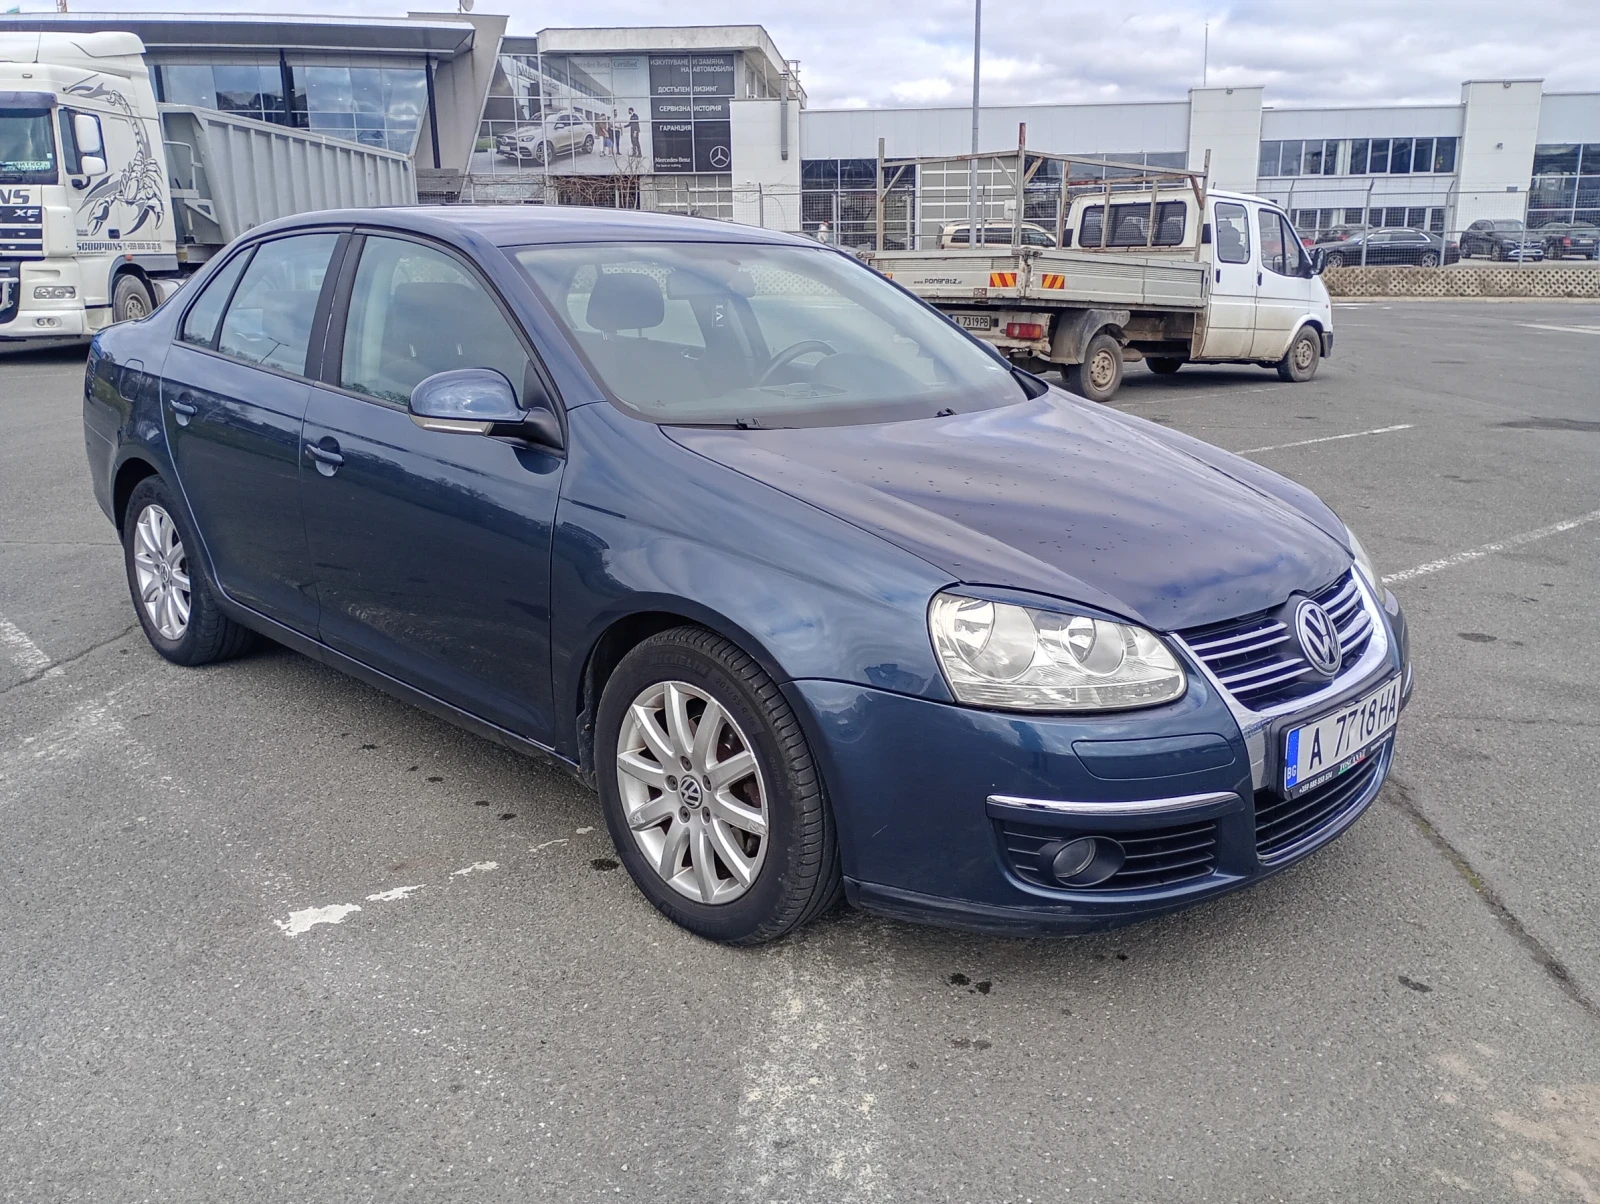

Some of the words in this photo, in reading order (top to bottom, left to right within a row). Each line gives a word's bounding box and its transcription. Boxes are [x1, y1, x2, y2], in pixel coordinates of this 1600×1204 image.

[692, 65, 734, 73] АВТОМОБИЛИ
[657, 86, 690, 94] ДОСТЪПЕН
[693, 85, 718, 93] ЛИЗИНГ
[693, 104, 722, 112] ИСТОРИЯ
[659, 124, 692, 132] ГАРАНЦИЯ
[13, 209, 40, 217] XF
[76, 242, 123, 251] SCORPIONS
[1308, 726, 1323, 771] A
[1286, 764, 1298, 780] BG
